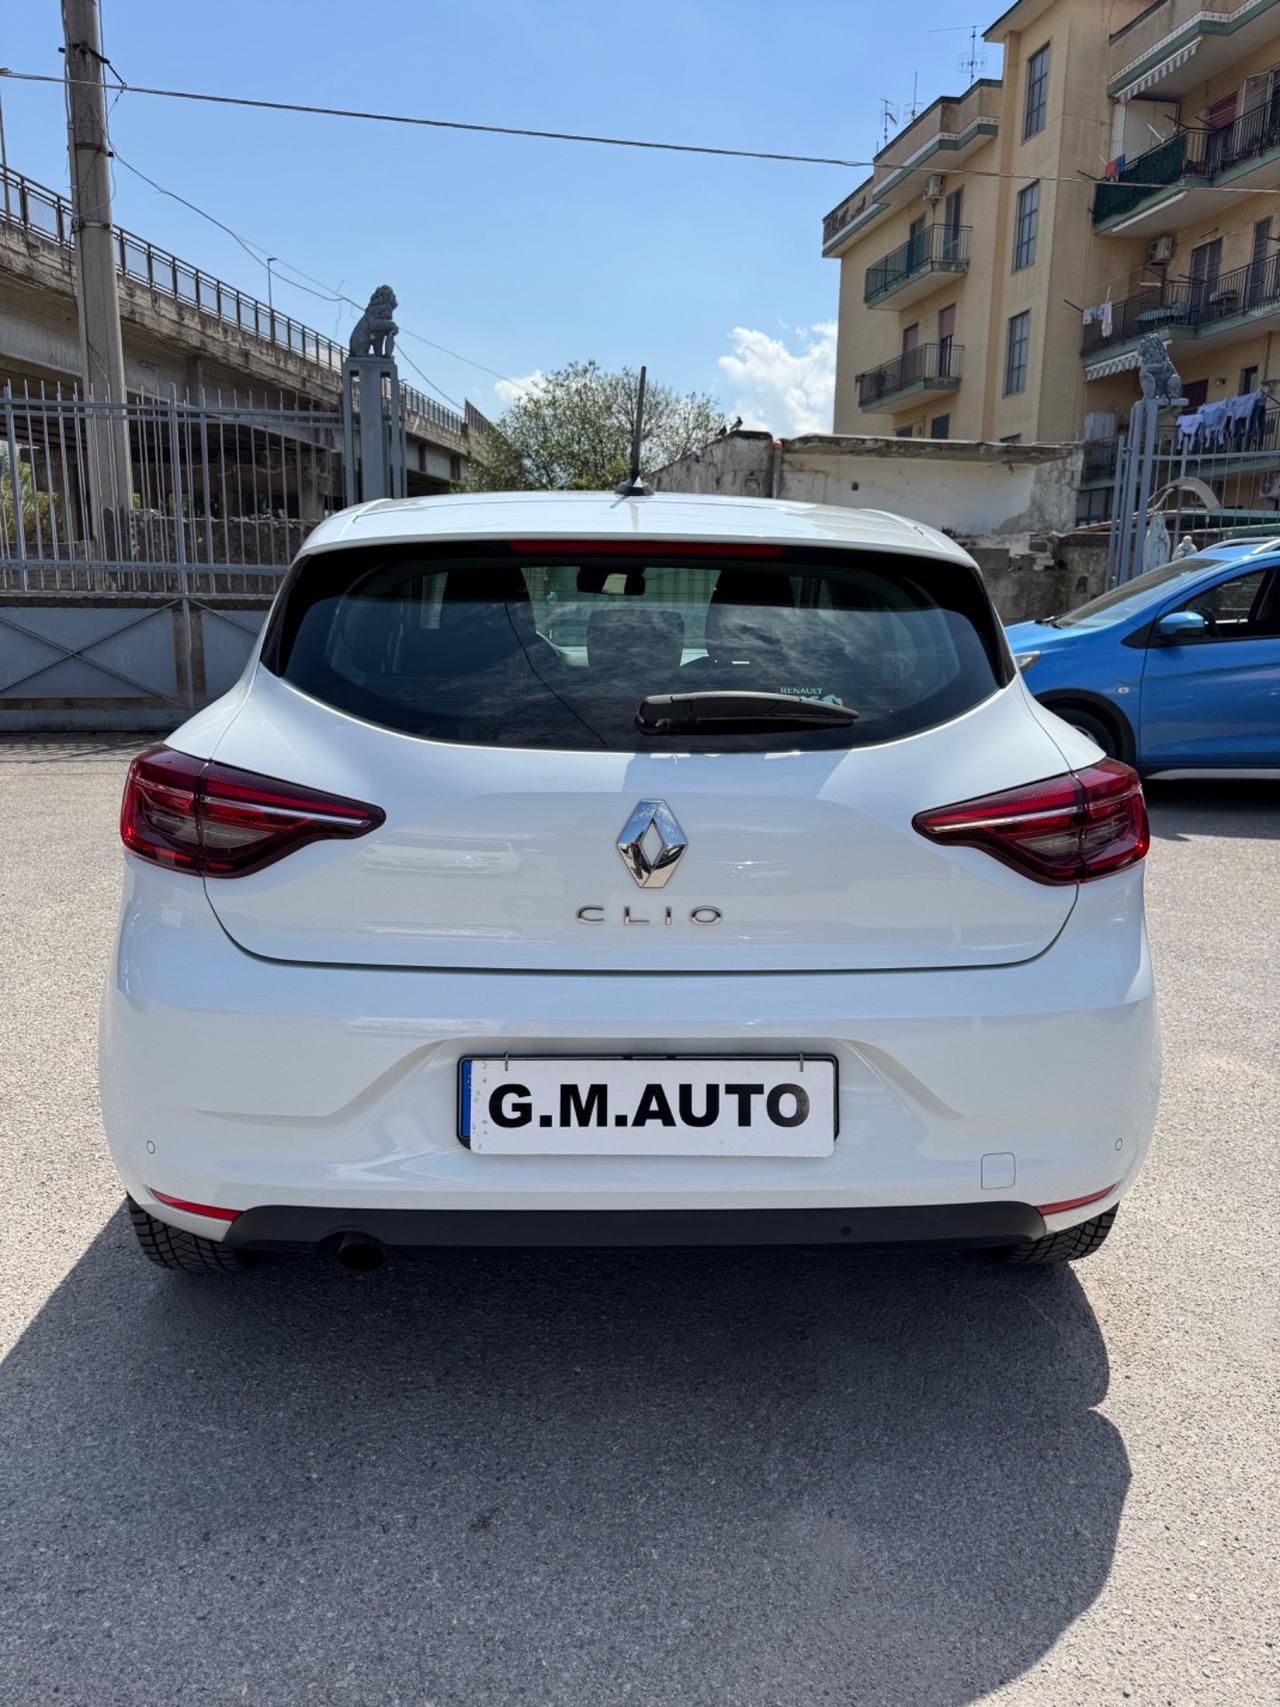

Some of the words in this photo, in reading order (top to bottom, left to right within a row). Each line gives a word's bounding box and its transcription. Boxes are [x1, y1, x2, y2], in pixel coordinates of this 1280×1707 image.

[780, 687, 824, 695] RENAULT
[576, 905, 722, 925] CLIO
[488, 1083, 811, 1128] G.M.AUTO
